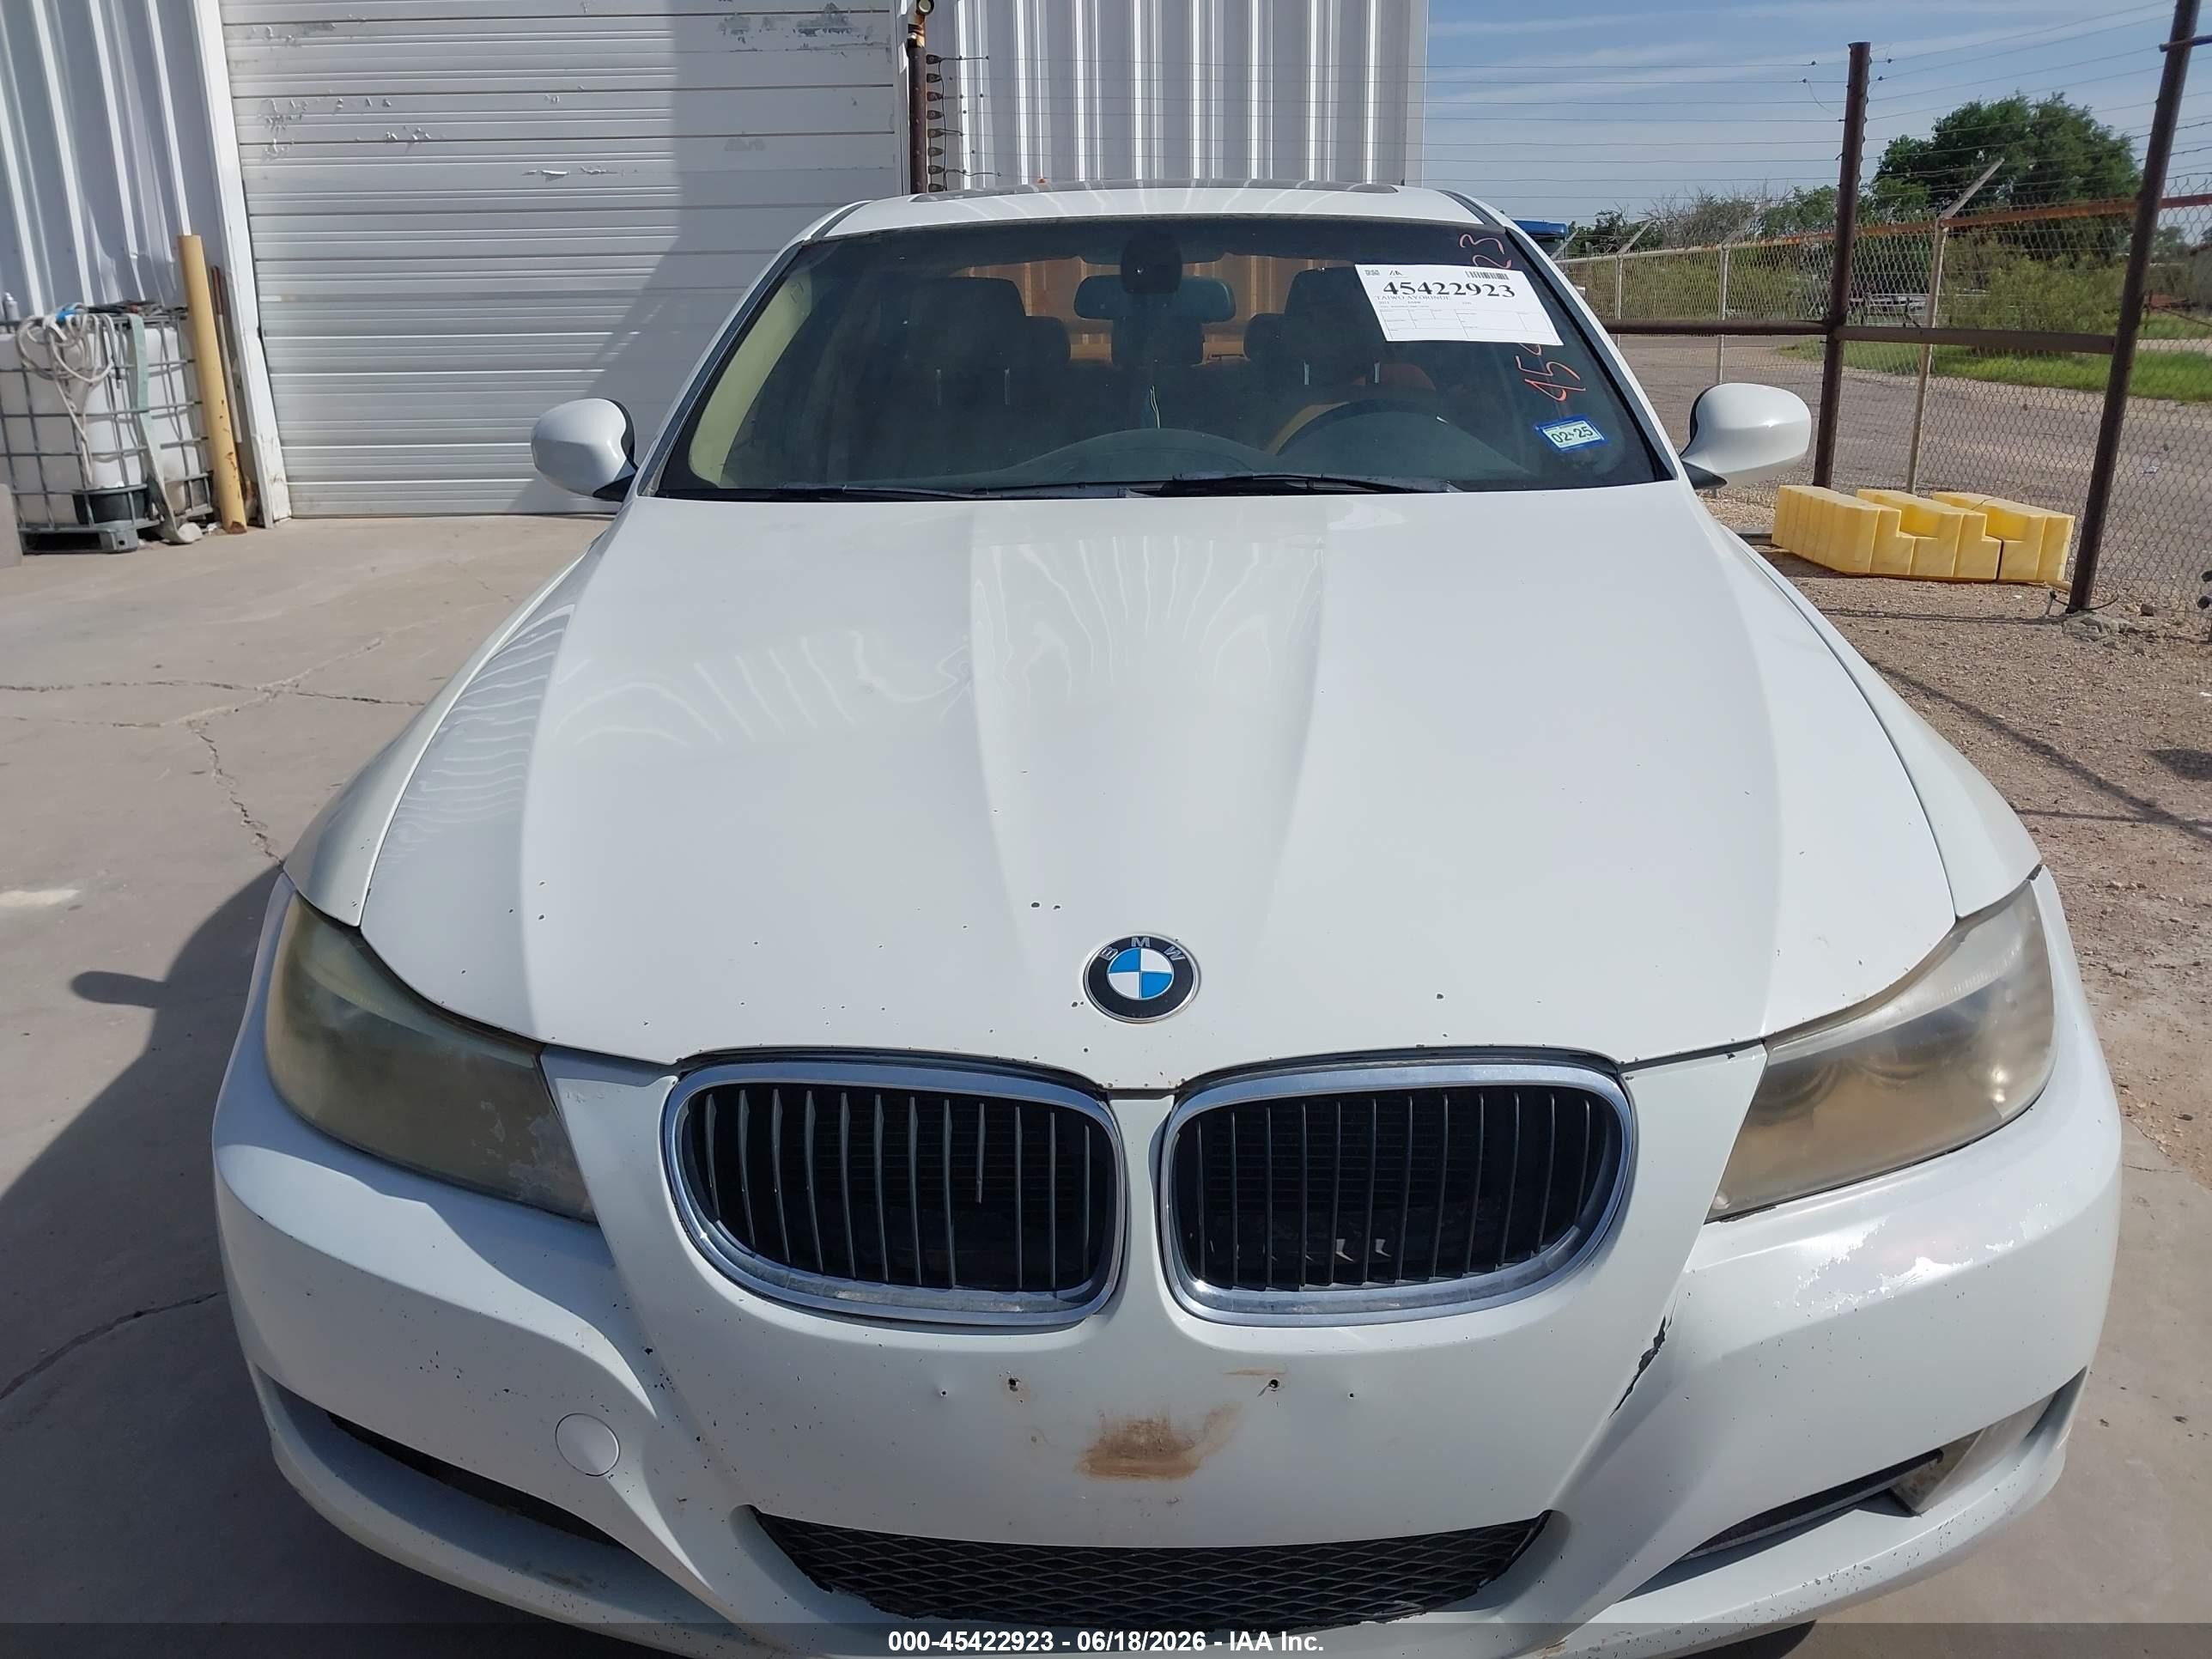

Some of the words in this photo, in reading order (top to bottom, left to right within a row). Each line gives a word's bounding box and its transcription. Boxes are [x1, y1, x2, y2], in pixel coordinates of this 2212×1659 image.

[1383, 282, 1516, 298] 45422923
[1551, 431, 1572, 443] 02
[1572, 426, 1593, 438] 25
[1098, 937, 1187, 961] BMW
